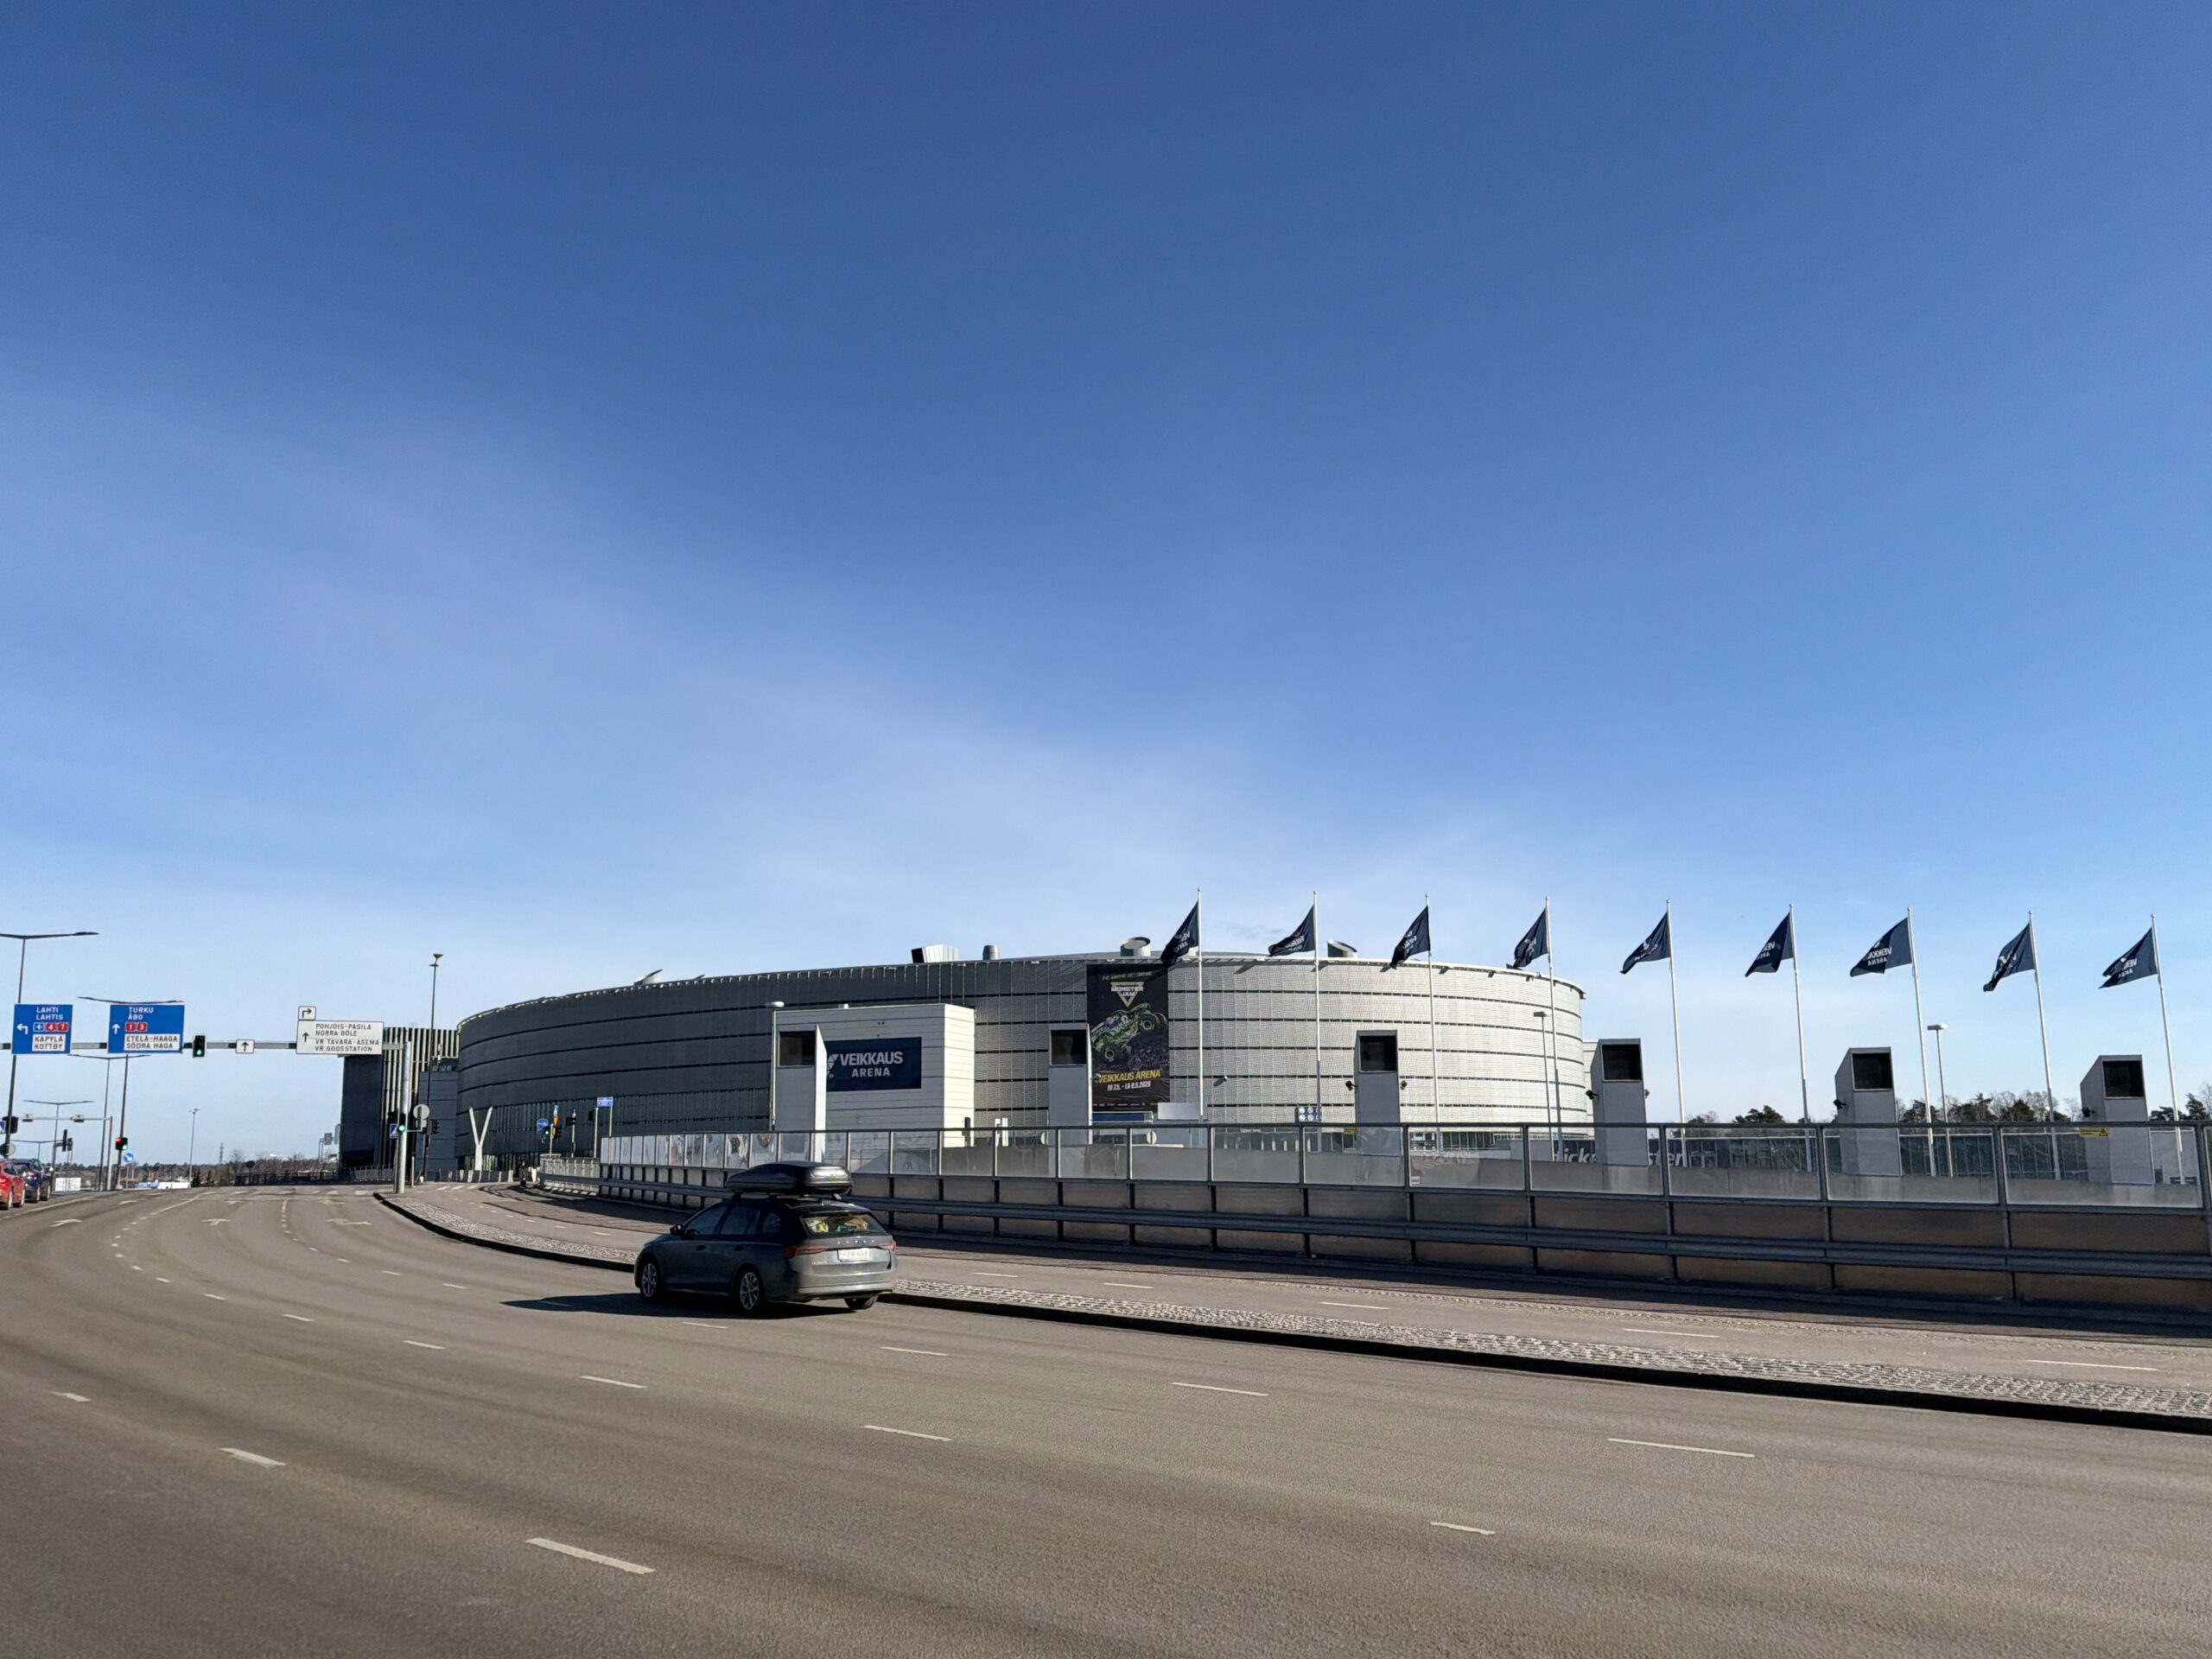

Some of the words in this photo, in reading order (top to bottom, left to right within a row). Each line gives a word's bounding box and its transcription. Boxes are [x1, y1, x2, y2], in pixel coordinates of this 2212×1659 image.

[840, 1051, 904, 1066] VEIKKAUS
[851, 1067, 891, 1078] ARENA
[1099, 1072, 1135, 1084] VEIKKAUS
[1135, 1070, 1161, 1080] ARENA
